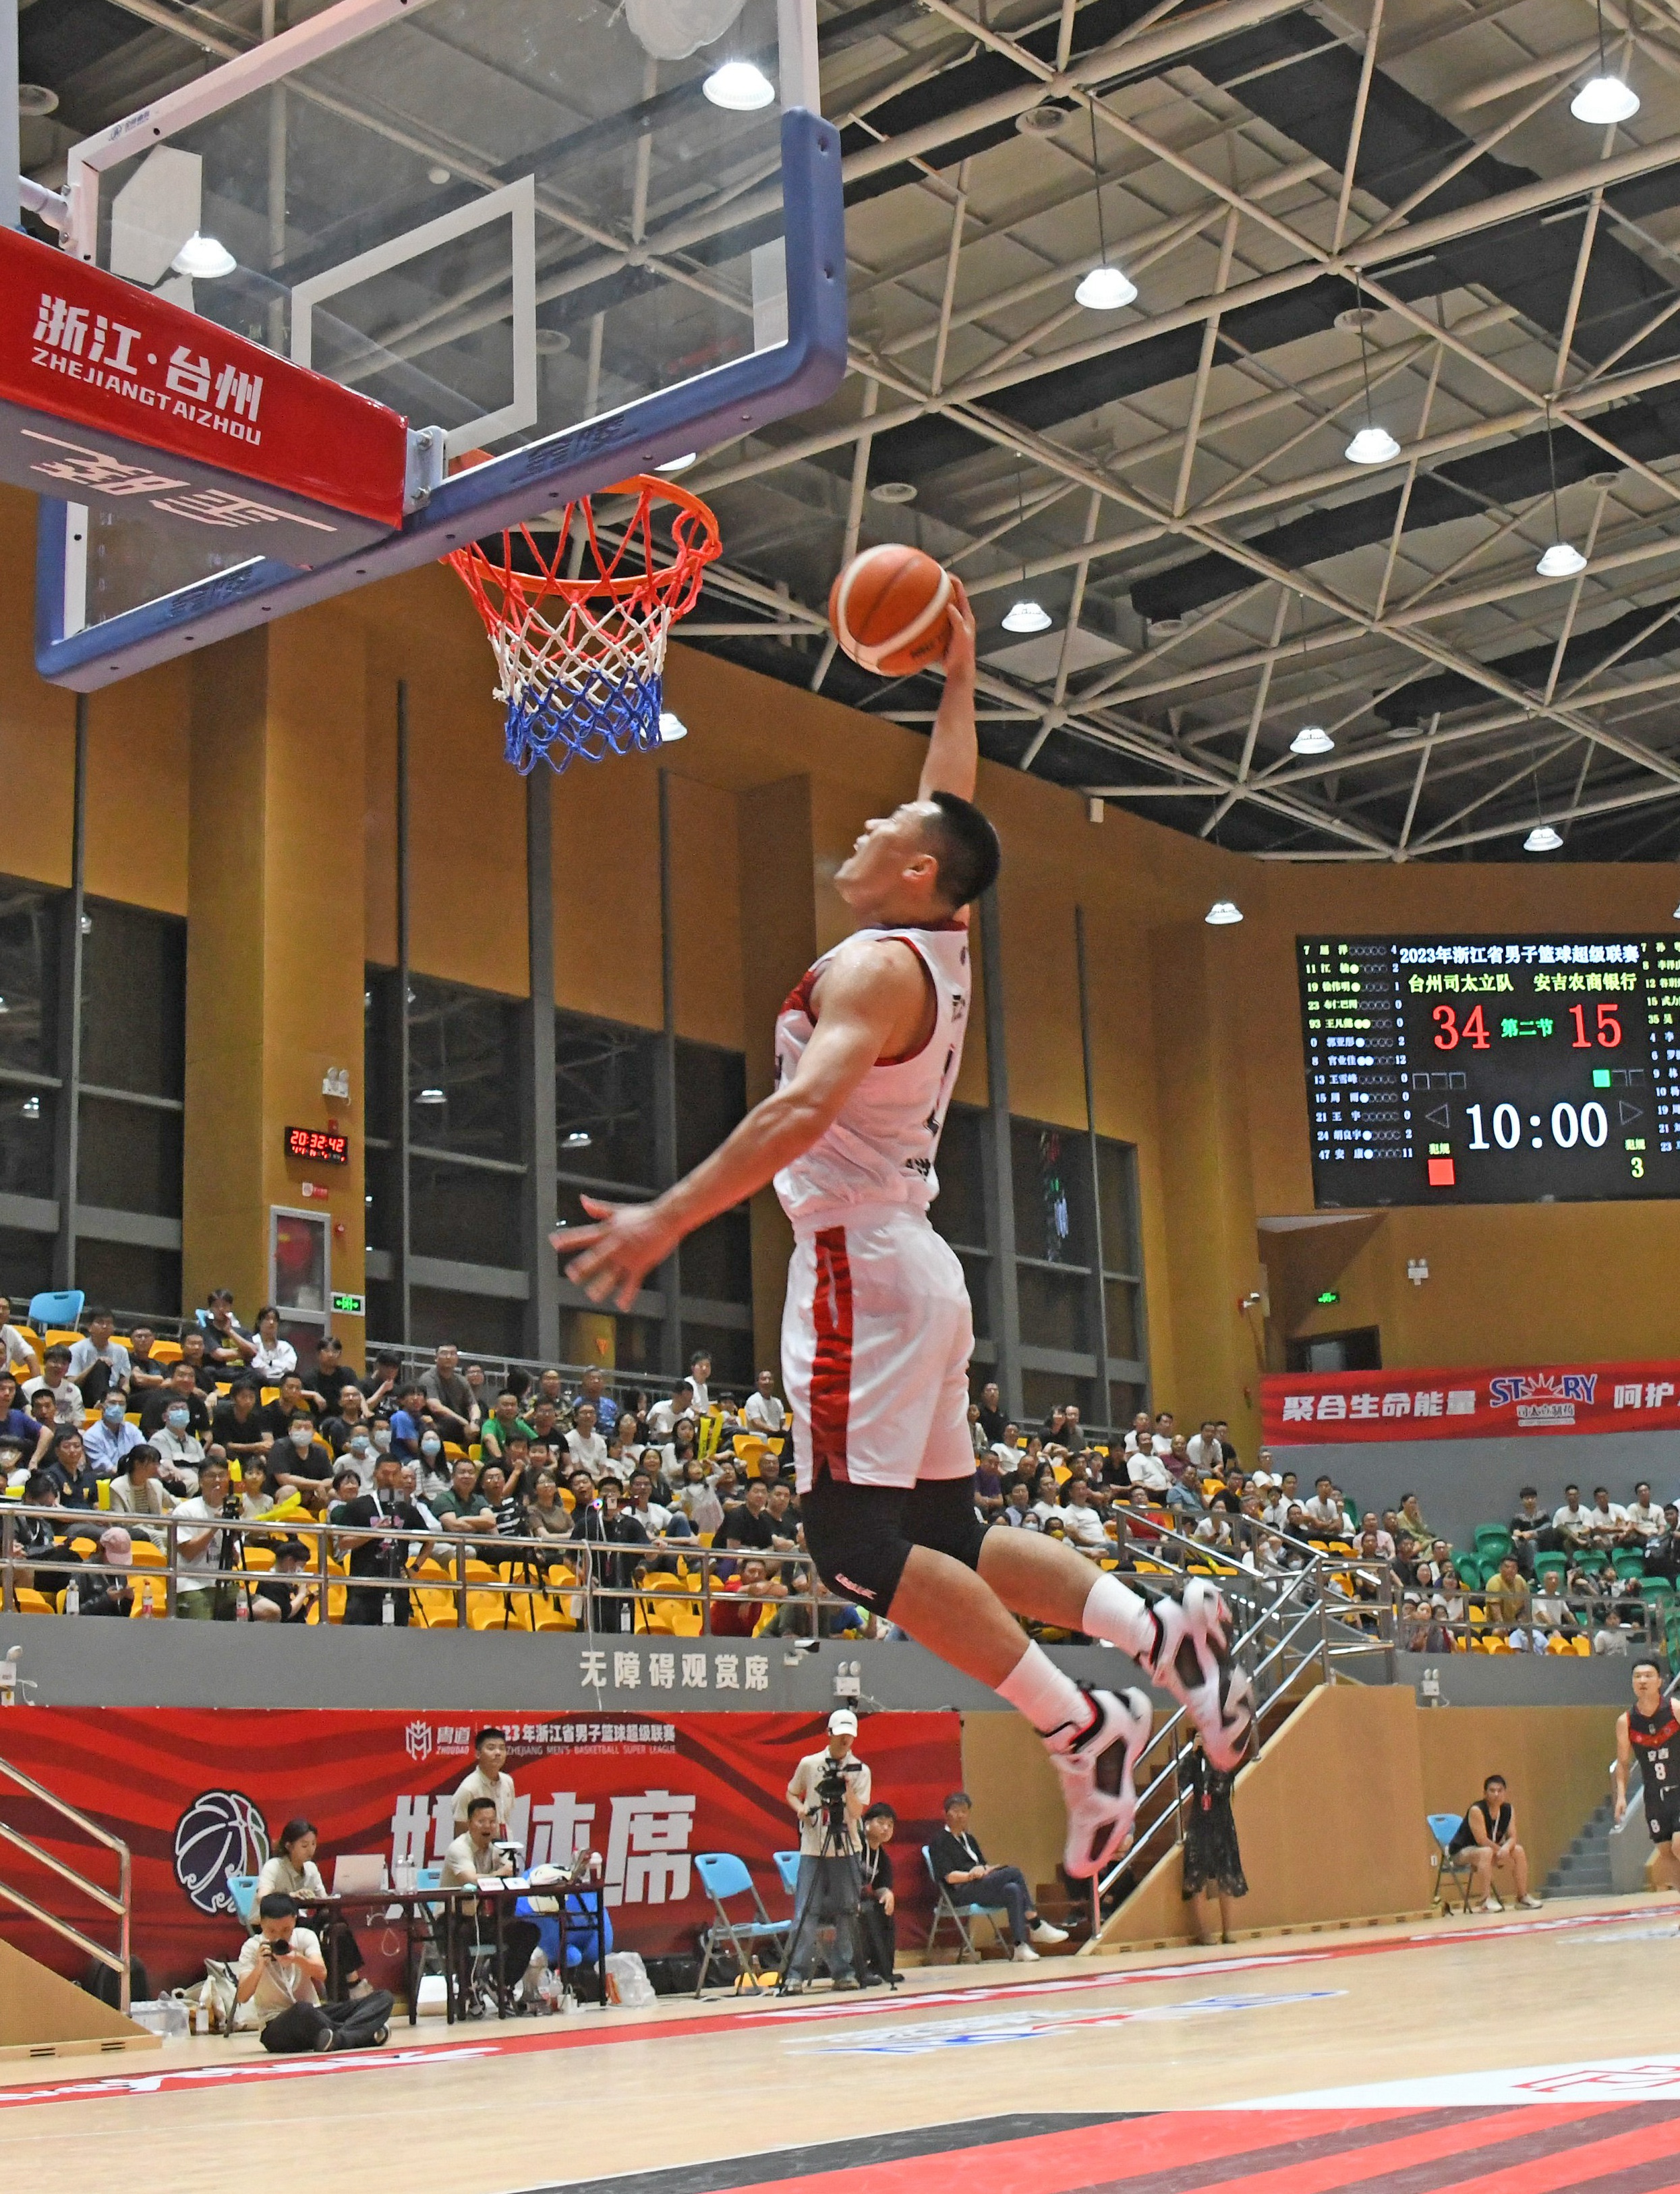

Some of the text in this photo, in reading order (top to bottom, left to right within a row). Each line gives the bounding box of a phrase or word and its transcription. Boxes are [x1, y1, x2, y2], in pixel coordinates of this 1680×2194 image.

[31, 347, 262, 446] ZHEJIANGTAIZHOU
[1304, 946, 1310, 955] 7
[1391, 945, 1397, 954] 4
[1641, 943, 1646, 952] 7
[1399, 944, 1640, 964] 2023年浙江省男子篮球超级联赛
[1306, 964, 1316, 973] 11
[1393, 963, 1399, 973] 2
[1308, 982, 1319, 991] 19
[1395, 982, 1399, 991] 1
[1408, 973, 1515, 994] 台州司太立队
[1533, 971, 1637, 993] 安吉农商银行
[1646, 979, 1656, 988] 12
[1308, 1001, 1319, 1010] 23
[1395, 1000, 1401, 1009] 0
[1647, 997, 1658, 1006] 15
[1309, 1019, 1321, 1029] 93
[1397, 1018, 1403, 1027] 0
[1648, 1014, 1659, 1024] 35
[1432, 1004, 1491, 1050] 34
[1500, 1018, 1554, 1038] 第二节
[1569, 1003, 1622, 1049] 15
[1310, 1038, 1317, 1047] 0
[1398, 1036, 1405, 1046] 2
[1650, 1033, 1656, 1042] 4
[1312, 1056, 1319, 1066] 8
[1395, 1055, 1406, 1064] 12
[1652, 1051, 1658, 1060] 6
[1314, 1075, 1325, 1085] 13
[1401, 1073, 1408, 1082] 0
[1653, 1069, 1660, 1078] 9
[1656, 1087, 1667, 1096] 10
[1316, 1093, 1327, 1103] 15
[1402, 1092, 1409, 1101] 0
[1658, 1105, 1669, 1115] 19
[1316, 1112, 1327, 1122] 21
[1404, 1110, 1411, 1120] 0
[1466, 1103, 1609, 1150] 10:00
[1659, 1124, 1669, 1133] 21
[1317, 1131, 1329, 1141] 24
[1406, 1129, 1412, 1138] 2
[290, 1130, 345, 1153] 20:32:42
[1660, 1142, 1672, 1151] 23
[1319, 1150, 1330, 1159] 47
[1403, 1148, 1412, 1157] 11
[1631, 1157, 1644, 1178] 3
[1614, 1382, 1680, 1409] 呵护
[1282, 1389, 1476, 1422] 聚合生命能量
[579, 1650, 770, 1691] 无障碍观赏席
[484, 1724, 675, 1743] 23年浙江省男子篮球超级联赛
[1654, 1762, 1666, 1780] 8
[1650, 1819, 1660, 1833] 8
